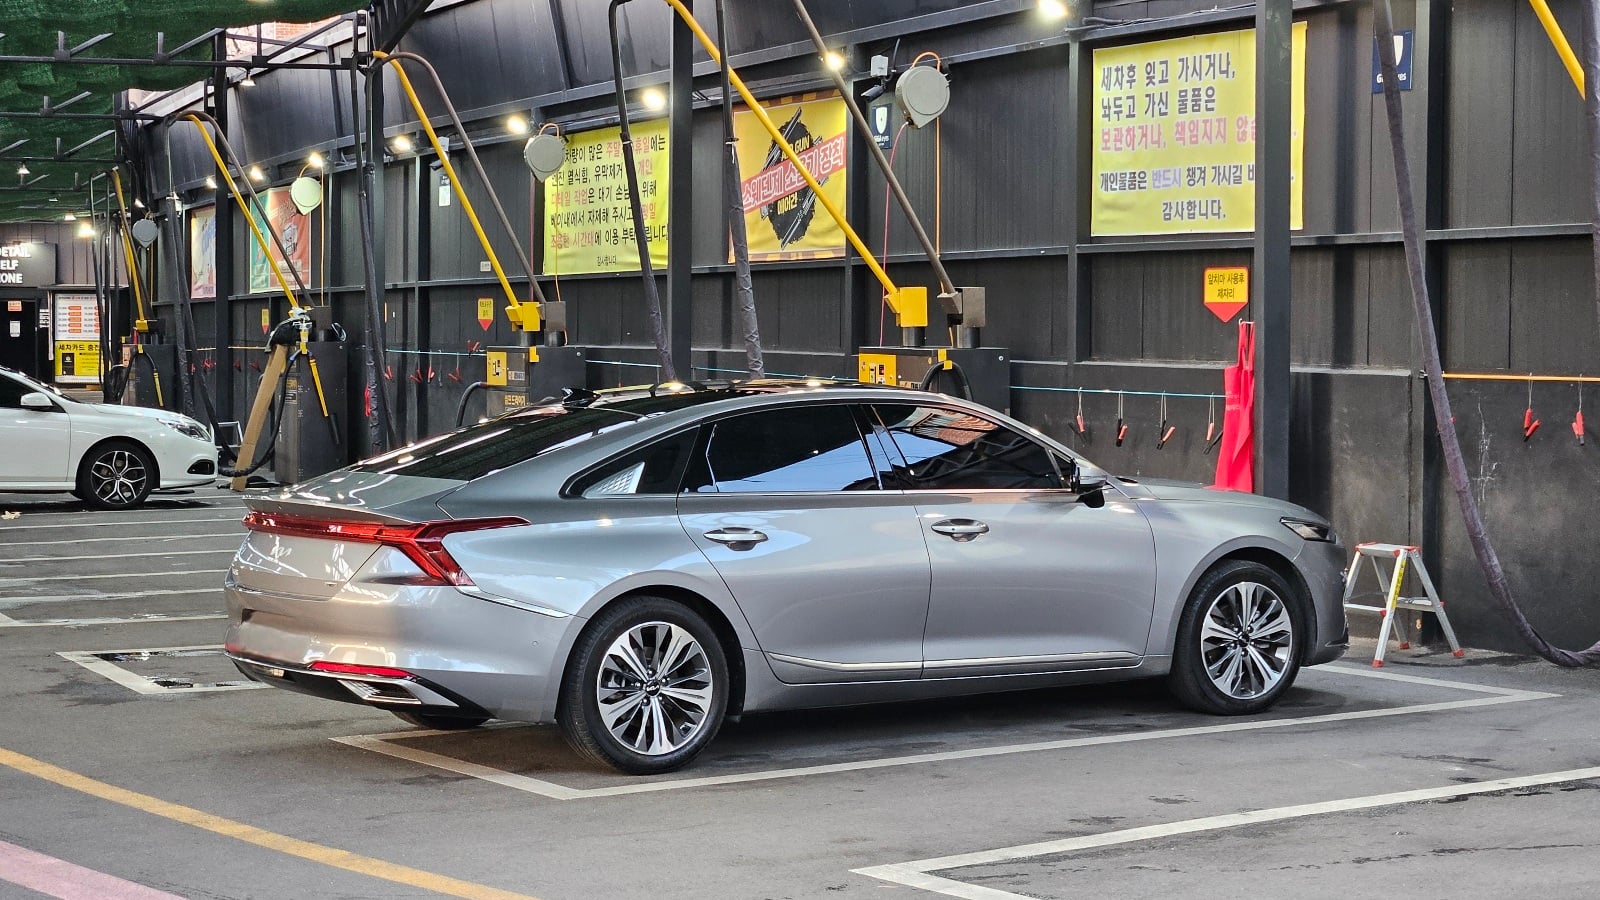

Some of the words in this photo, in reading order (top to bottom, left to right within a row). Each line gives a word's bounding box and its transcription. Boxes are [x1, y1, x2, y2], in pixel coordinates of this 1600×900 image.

[1101, 63, 1137, 92] 세차후
[1144, 59, 1169, 88] 잊고
[1177, 52, 1235, 83] 가시거나,
[1144, 91, 1169, 119] 가신
[1177, 86, 1215, 115] 물품은
[795, 135, 811, 154] GUN
[1101, 124, 1167, 151] 보관하거나,
[1174, 117, 1228, 146] 책임지지
[588, 143, 603, 161] 많은
[820, 136, 844, 175] 장착
[594, 163, 623, 182] 유막제거
[638, 159, 653, 176] 개인
[1100, 169, 1148, 193] 개인물품은
[1152, 167, 1183, 189] 반드시
[1186, 166, 1207, 188] 챙겨
[1210, 163, 1244, 186] 가시길
[573, 187, 595, 205] 작업은
[598, 185, 612, 202] 대기
[642, 180, 657, 197] 위해
[587, 207, 609, 225] 자제해
[1162, 199, 1226, 222] 감사합니다.
[573, 229, 602, 247] 시간대에
[604, 228, 619, 246] 이용
